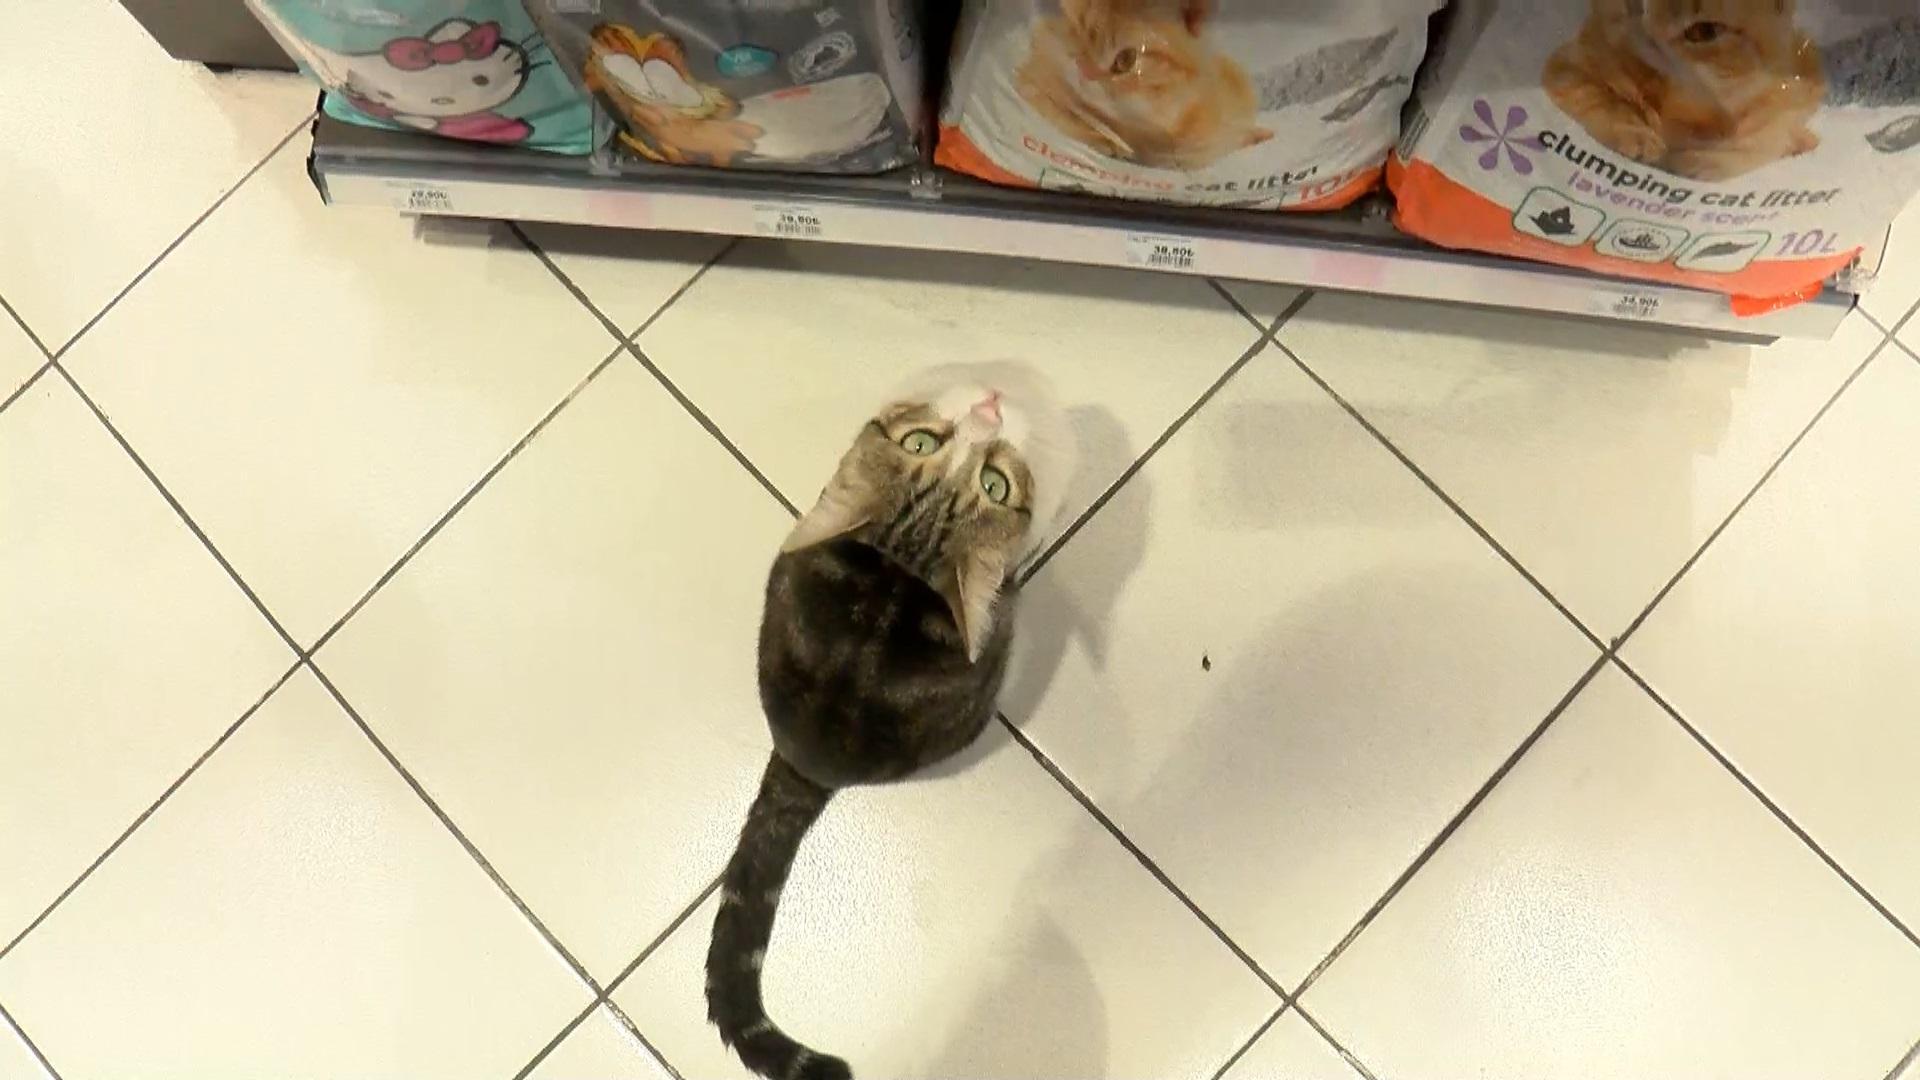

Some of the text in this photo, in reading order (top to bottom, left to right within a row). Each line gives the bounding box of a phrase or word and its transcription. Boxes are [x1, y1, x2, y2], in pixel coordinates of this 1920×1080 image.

[1185, 180, 1239, 193] cat
[1247, 165, 1320, 190] litter
[1537, 130, 1841, 208] clumping cat litter
[1567, 169, 1697, 220] lavender
[1774, 229, 1839, 256] 10L
